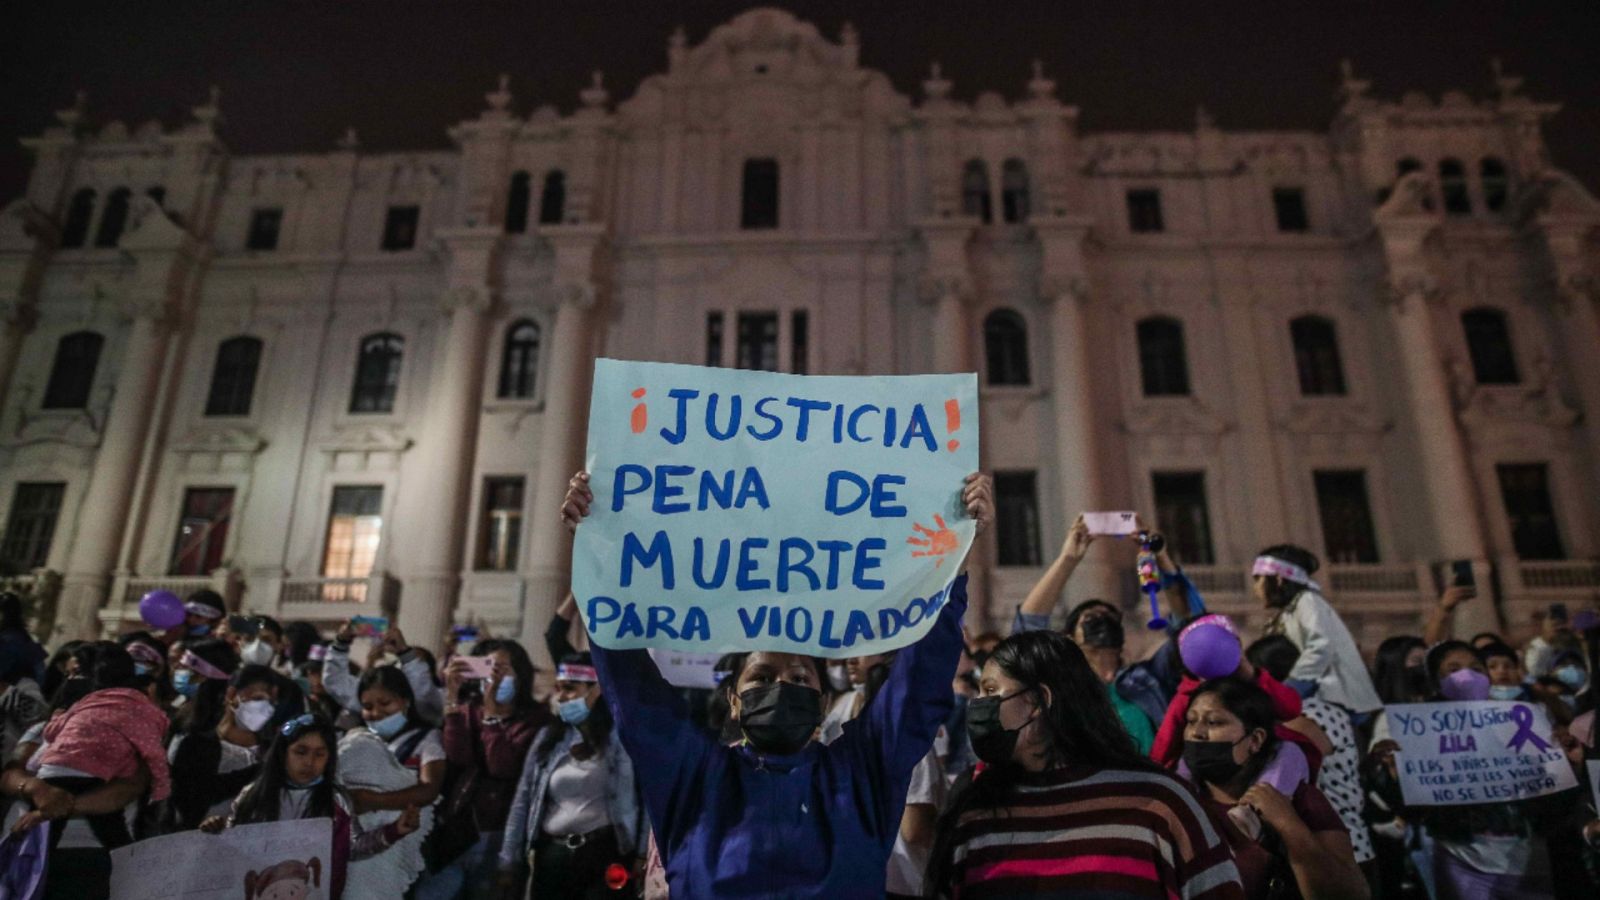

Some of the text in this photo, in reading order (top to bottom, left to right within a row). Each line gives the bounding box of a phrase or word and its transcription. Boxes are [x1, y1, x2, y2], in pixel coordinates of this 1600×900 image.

[630, 387, 961, 453] ¡JUSTICIA!
[611, 464, 908, 518] PENA DE
[620, 530, 887, 593] MUERTE
[587, 596, 711, 641] PARA
[1394, 712, 1426, 736] YO
[1431, 709, 1466, 732] SOY
[1432, 789, 1453, 802] NO
[1458, 788, 1477, 800] SE
[1483, 784, 1511, 798] LES
